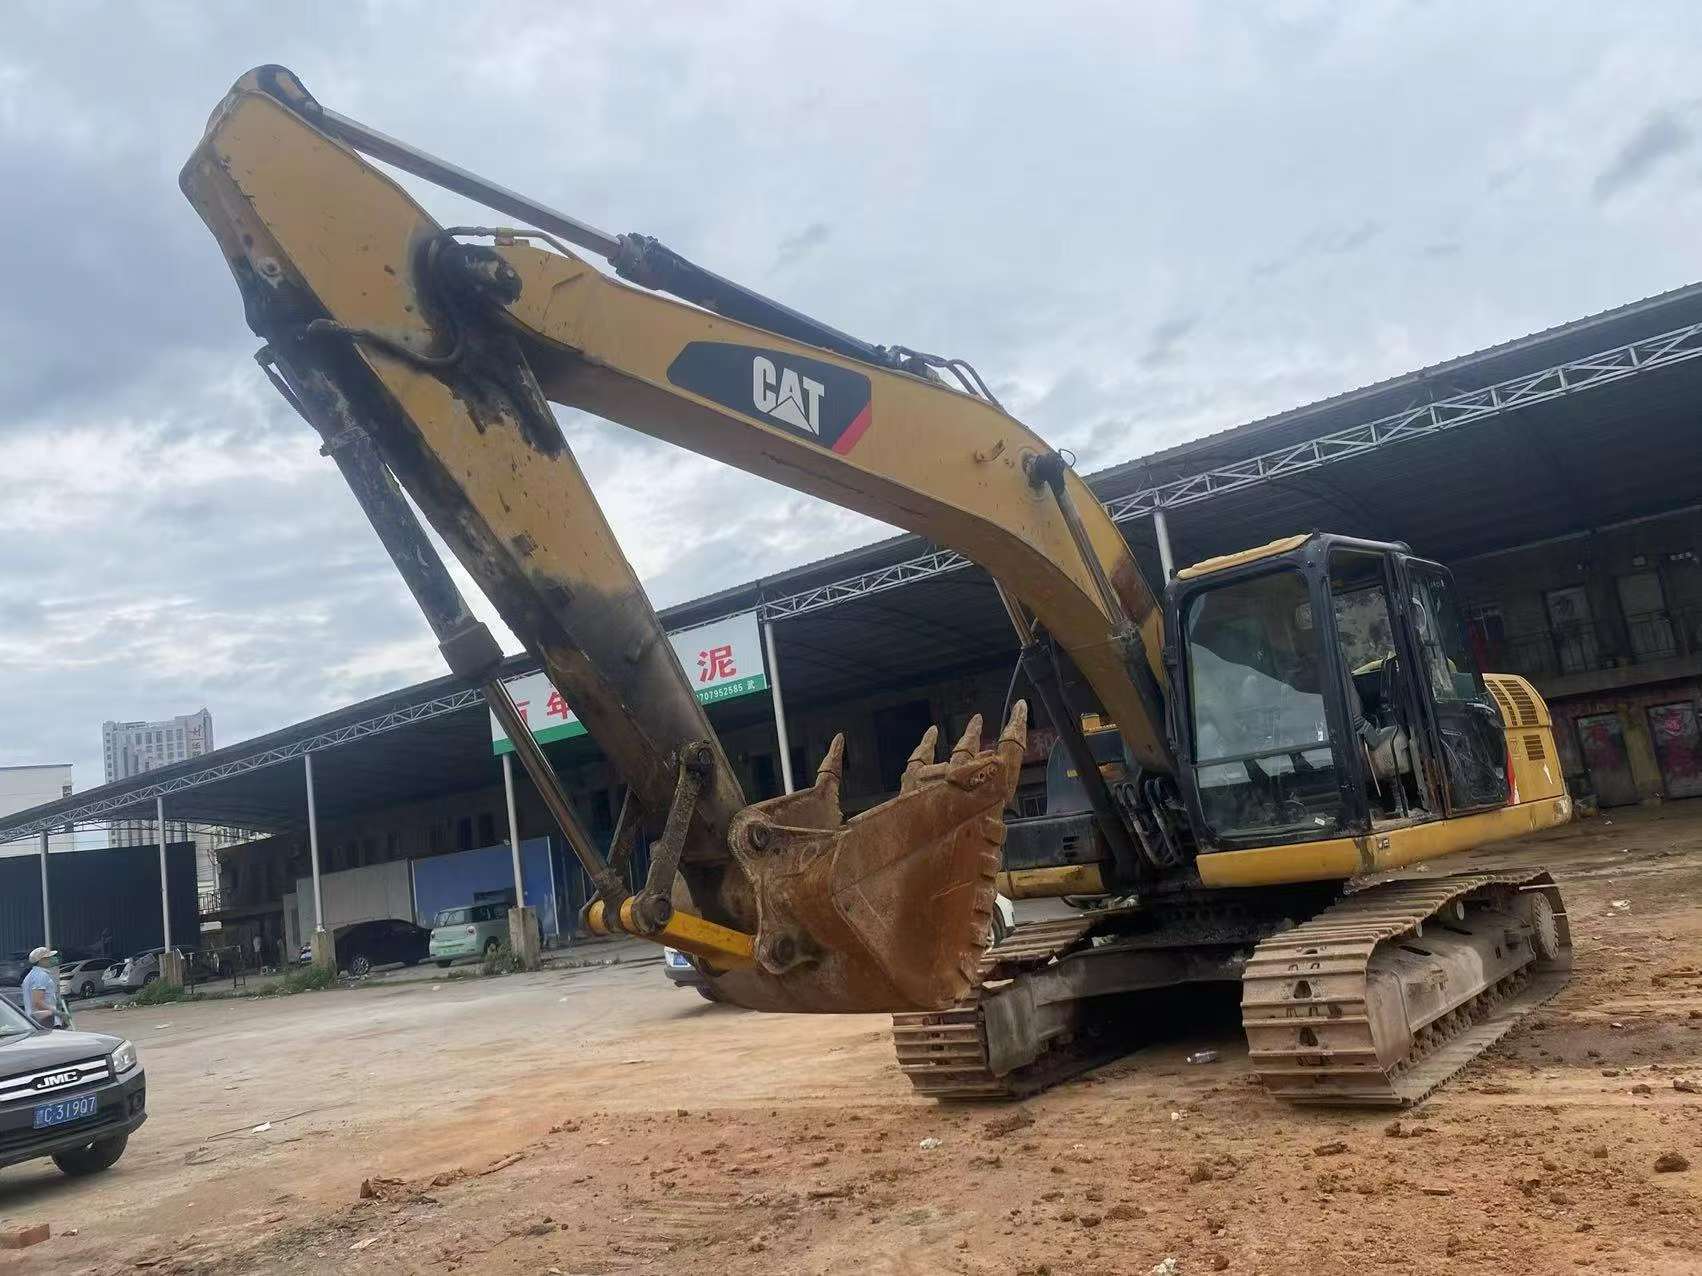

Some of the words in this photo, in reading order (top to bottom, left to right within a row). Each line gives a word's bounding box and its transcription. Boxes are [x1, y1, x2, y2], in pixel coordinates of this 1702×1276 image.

[752, 355, 825, 436] CAT
[697, 645, 737, 682] 泥
[37, 1071, 78, 1089] JMC
[37, 1097, 96, 1126] C31907
